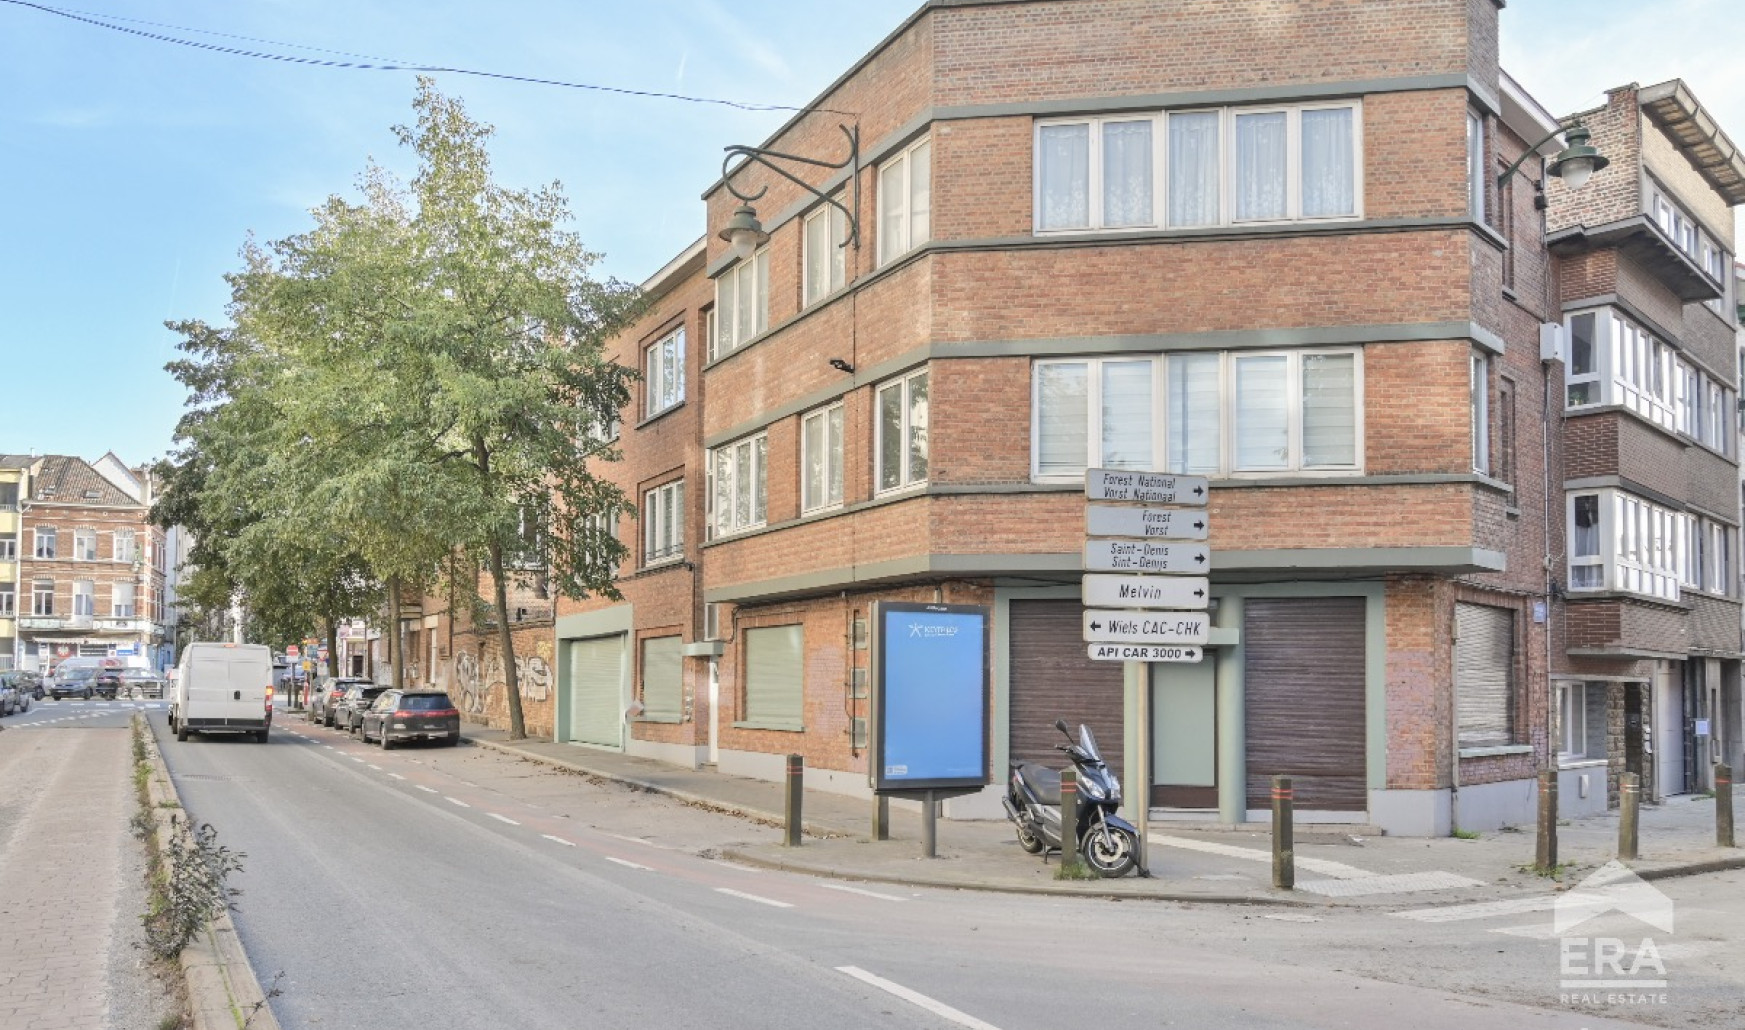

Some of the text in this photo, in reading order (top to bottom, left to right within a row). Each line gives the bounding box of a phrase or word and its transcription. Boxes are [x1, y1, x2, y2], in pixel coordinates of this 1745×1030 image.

[1103, 473, 1176, 489] Forest National
[1104, 486, 1176, 502] Vorst Nationaal
[1142, 509, 1171, 523] Forest
[1145, 524, 1168, 536] Vorst
[1110, 542, 1169, 556] Saint-Denis
[1111, 556, 1168, 571] Sint-Denijs
[1119, 584, 1161, 599] Melvin
[1108, 620, 1201, 636] Wiels CAC-CHK
[1097, 647, 1182, 659] API CAR 3000
